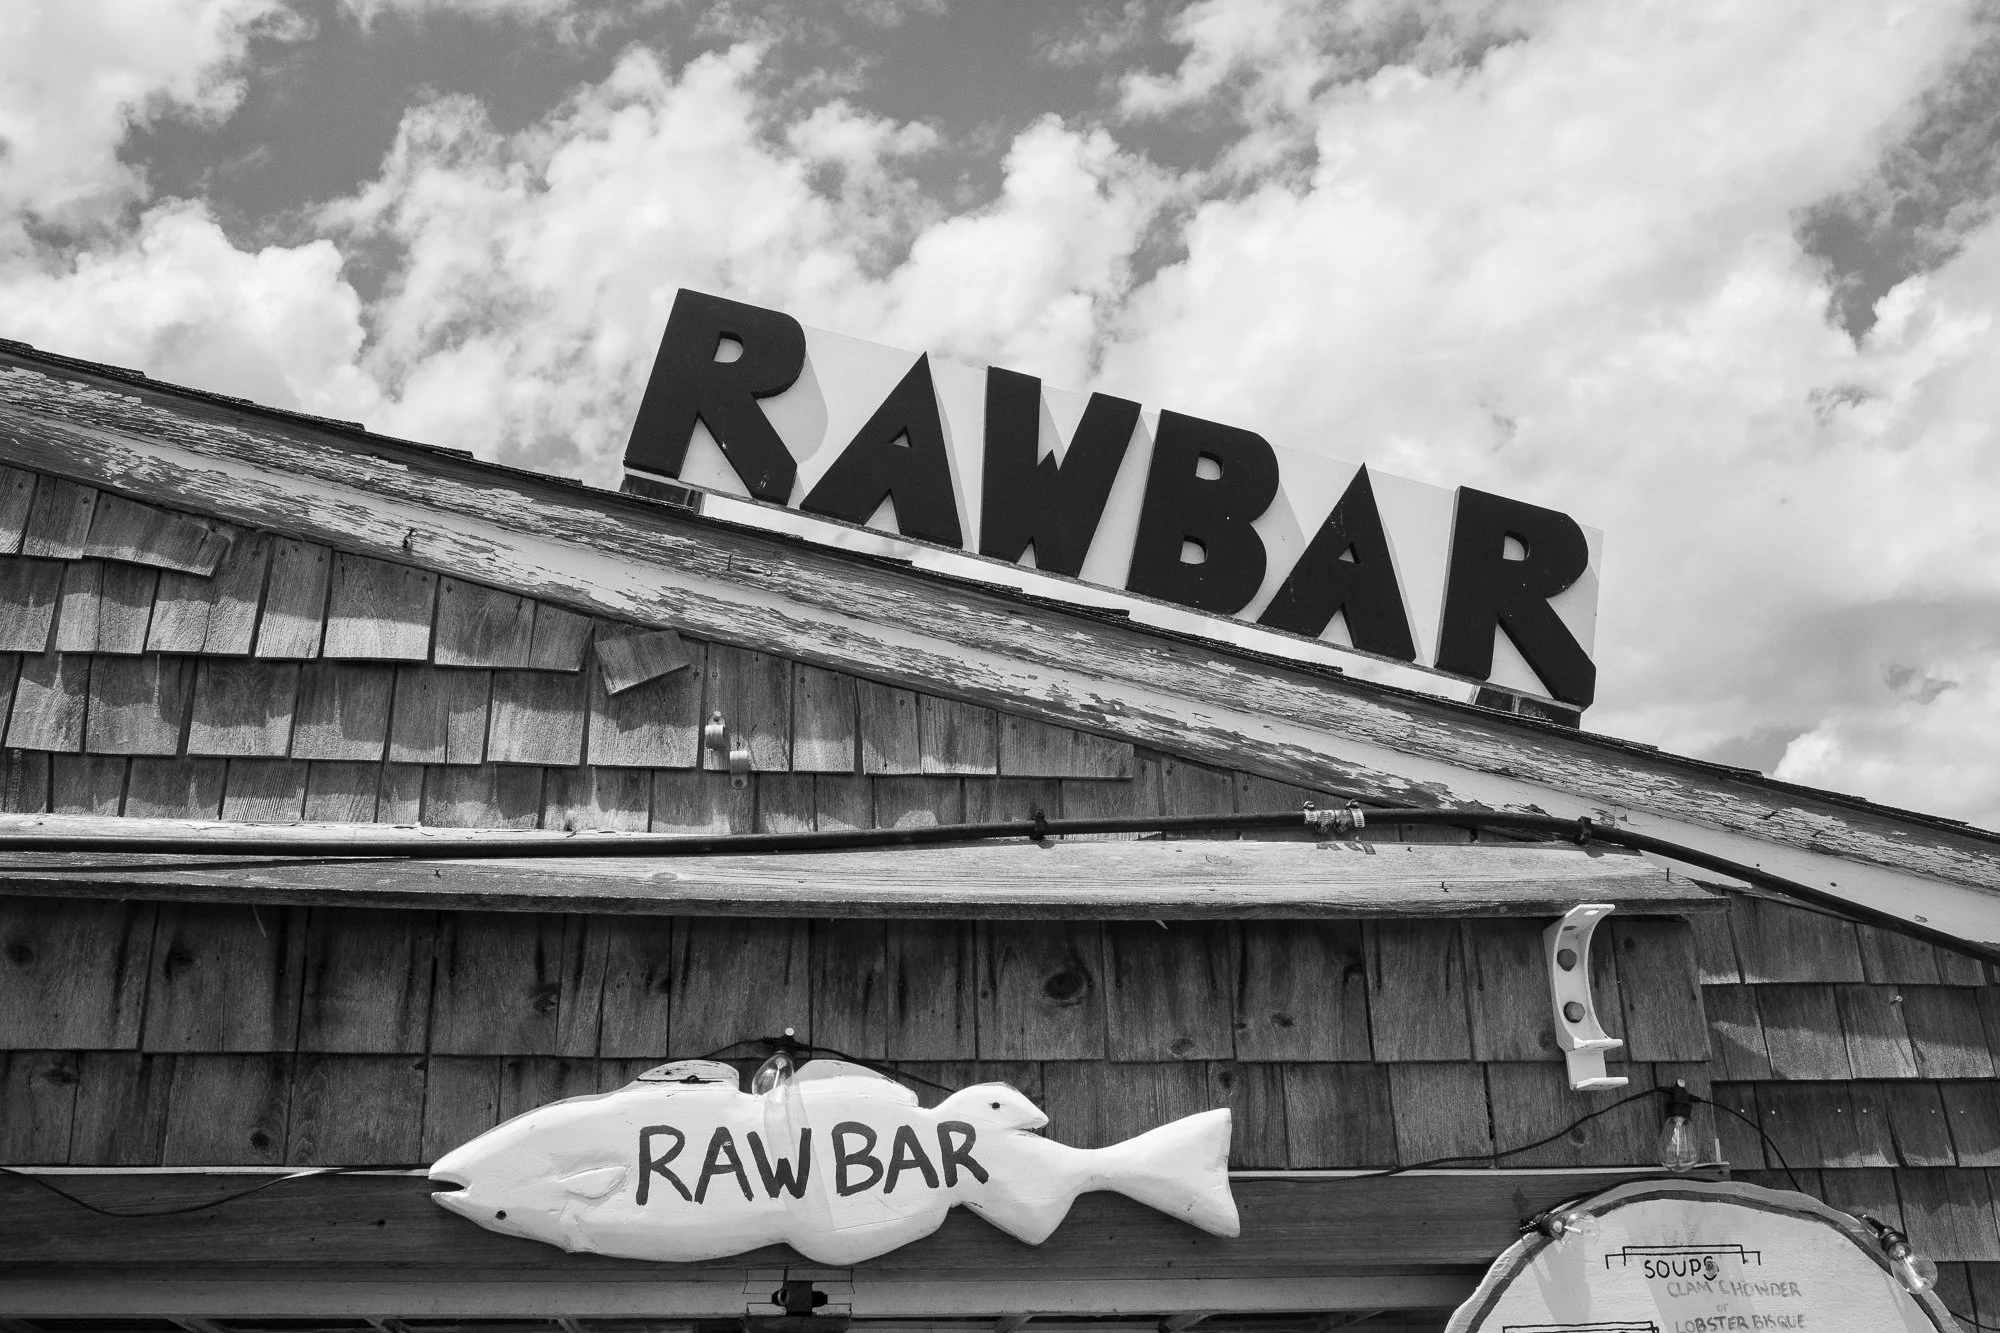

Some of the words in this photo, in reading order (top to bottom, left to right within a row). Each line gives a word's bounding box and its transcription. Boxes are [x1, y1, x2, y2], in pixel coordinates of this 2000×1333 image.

[636, 1125, 812, 1205] RAW
[831, 1121, 990, 1197] BAR
[1644, 1255, 1720, 1281] SOUPS
[1667, 1279, 1713, 1298] CLAM
[1718, 1281, 1803, 1298] CHOWDER
[1675, 1315, 1751, 1333] LOBSTER
[1752, 1314, 1808, 1331] BISQUE
